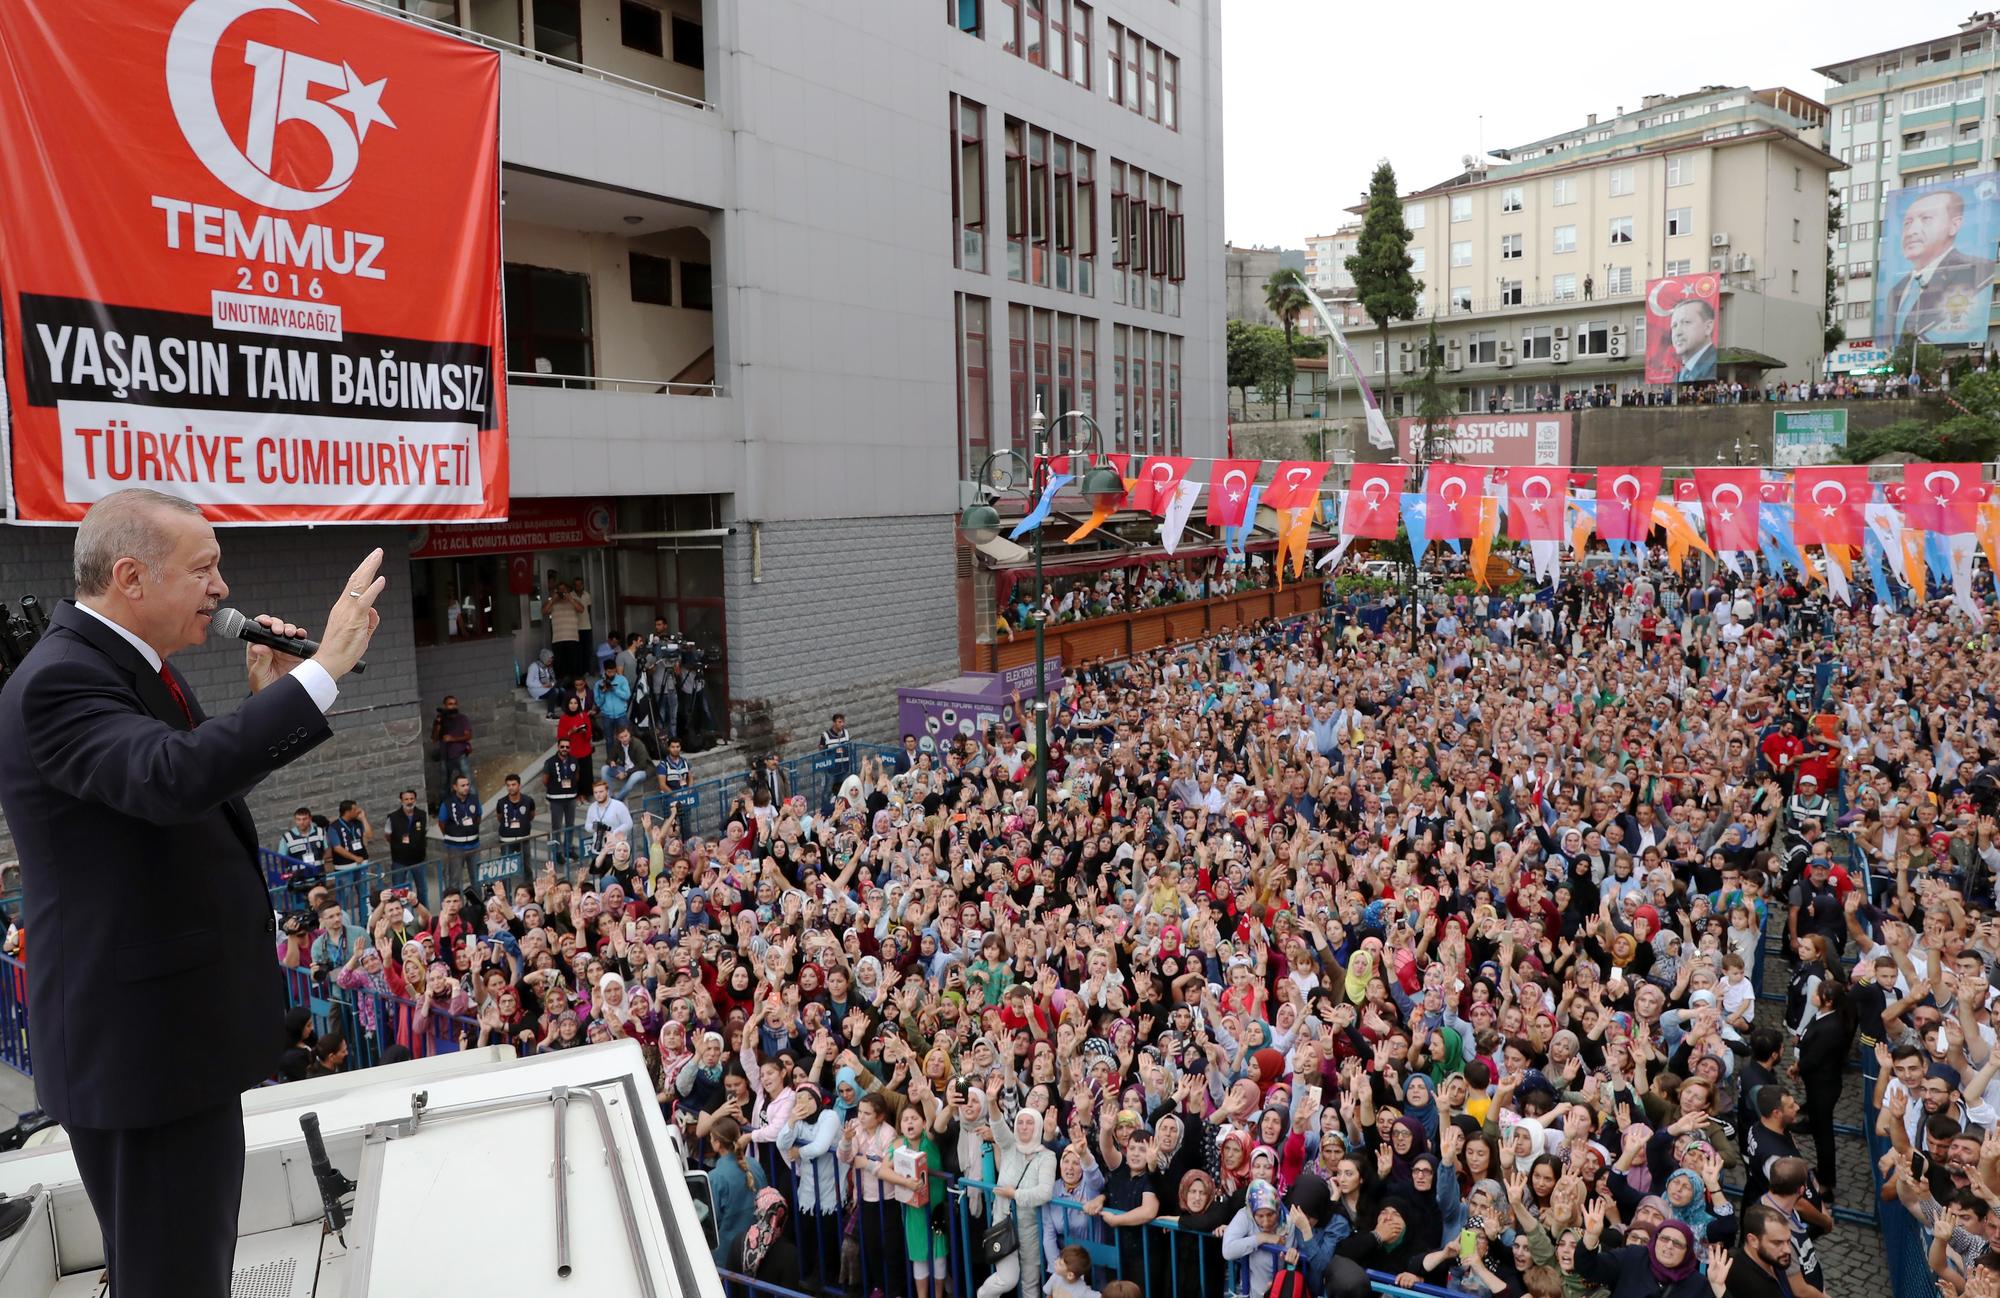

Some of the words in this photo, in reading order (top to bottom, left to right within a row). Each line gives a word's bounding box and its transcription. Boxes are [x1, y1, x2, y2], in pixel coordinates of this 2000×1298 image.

[151, 195, 386, 281] TEMMUZ
[236, 266, 324, 300] 2016
[217, 300, 338, 334] UNUTMAYACAĞIZ
[36, 323, 230, 400] YAŞASIN
[239, 345, 320, 403] TAM
[331, 349, 485, 413] BAĞIMSIZ
[75, 420, 246, 485] TÜRKİYE
[256, 434, 471, 487] CUMHURİYETİ
[432, 538, 449, 551] 112
[472, 534, 508, 548] KOMUTA
[509, 532, 548, 546] KONTROL
